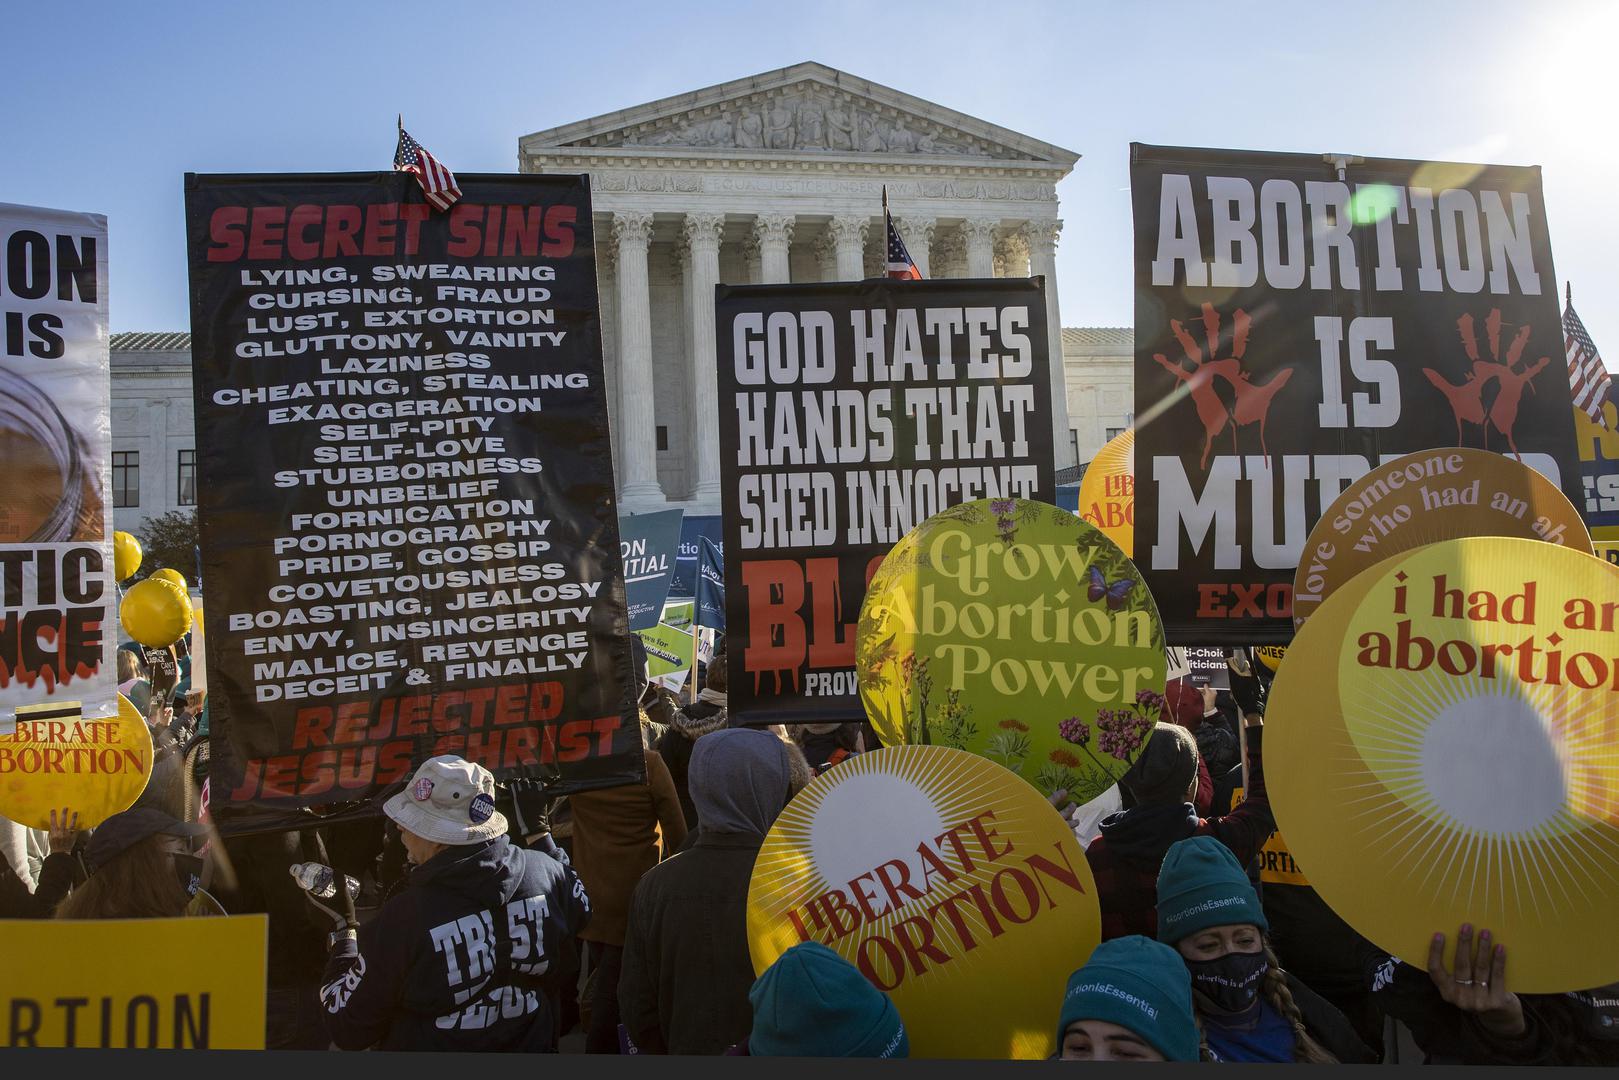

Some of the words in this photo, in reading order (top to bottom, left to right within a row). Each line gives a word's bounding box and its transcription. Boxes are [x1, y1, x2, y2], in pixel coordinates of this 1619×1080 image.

[771, 179, 824, 192] JUSTICE
[830, 181, 877, 193] UNDER
[207, 202, 430, 263] SECRET
[447, 204, 577, 259] SINS
[1151, 172, 1542, 296] ABORTION
[0, 229, 97, 304] ON
[241, 266, 358, 286] LYING,
[372, 264, 556, 282] SWEARING
[247, 311, 349, 334] LUST,
[364, 307, 554, 327] EXTORTION
[248, 287, 423, 310] CURSING,
[437, 286, 551, 303] FRAUD
[5, 311, 65, 359] IS
[235, 332, 433, 358] GLUTTONY,
[445, 330, 567, 348] VANITY
[733, 311, 836, 385] GOD
[850, 306, 1032, 383] HATES
[321, 352, 491, 374] LAZINESS
[1314, 315, 1401, 429] IS
[212, 379, 409, 406] CHEATING,
[423, 373, 589, 392] STEALING
[268, 397, 541, 424] EXAGGERATION
[313, 437, 505, 463] SELF-LOVE
[320, 417, 495, 441] SELF-PITY
[736, 388, 895, 467] HANDS
[905, 384, 1035, 461] THAT
[273, 457, 542, 488] STUBBORNESS
[327, 479, 499, 508] UNBELIEF
[291, 499, 534, 531] FORNICATION
[738, 471, 836, 549] SHED
[1296, 542, 1336, 602] love
[1333, 454, 1464, 535] someone
[1353, 504, 1412, 553] who
[1419, 480, 1480, 511] had
[1490, 491, 1528, 519] an
[274, 519, 551, 555] PORNOGRAPHY
[279, 551, 404, 577] PRIDE,
[417, 540, 550, 567] GOSSIP
[268, 563, 566, 603] COVETOUSNESS
[929, 530, 1099, 595] Grow
[229, 597, 430, 632] BOASTING,
[446, 581, 601, 611] JEALOSY
[871, 584, 1151, 648] Abortion
[1393, 570, 1409, 614] i
[1432, 574, 1537, 625] had
[244, 630, 354, 656] ENVY,
[369, 606, 592, 643] INSINCERITY
[253, 650, 408, 681] MALICE,
[422, 631, 588, 663] REVENGE
[656, 638, 669, 648] for
[1357, 619, 1619, 692] abortio
[255, 671, 393, 703] DECEIT
[405, 666, 431, 687] &
[446, 652, 588, 682] FINALLY
[936, 644, 1153, 703] Power
[291, 681, 565, 750] REJECTED
[231, 740, 416, 801] JESUS
[432, 715, 621, 770] CHRIST
[471, 797, 494, 818] JESUS
[786, 810, 1014, 945] LIBERATE
